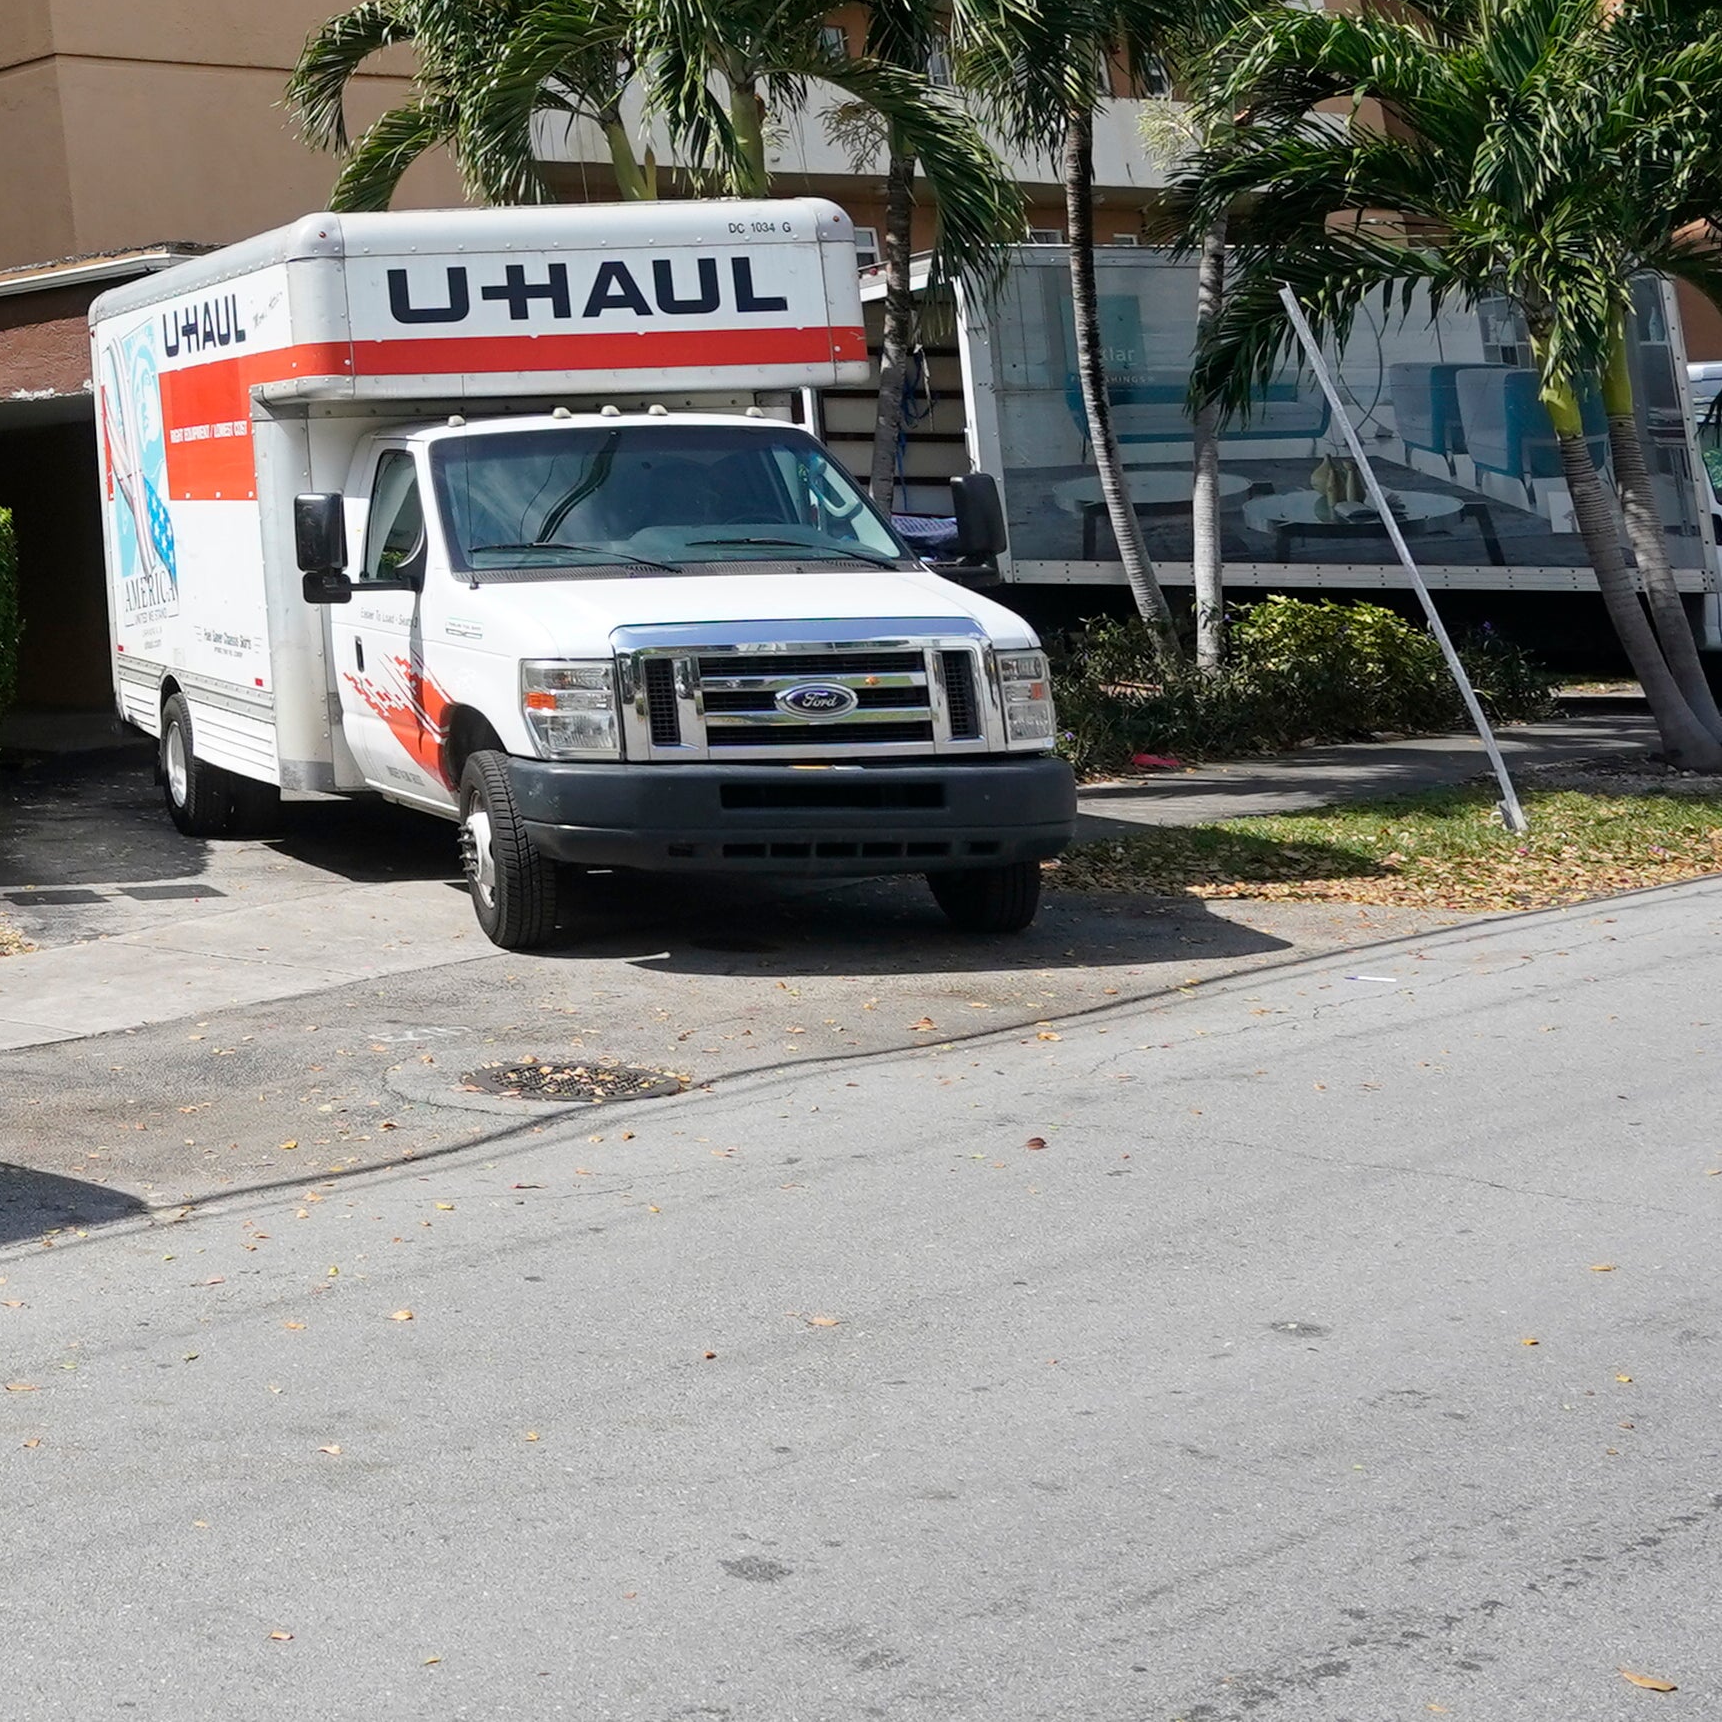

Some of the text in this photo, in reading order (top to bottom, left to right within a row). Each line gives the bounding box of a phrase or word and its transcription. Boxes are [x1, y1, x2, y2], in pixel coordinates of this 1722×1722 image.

[728, 221, 792, 234] DC 1034 G
[386, 256, 788, 325] U-HAUL
[162, 293, 247, 358] U-HAUL
[125, 569, 176, 613] AMERICA
[801, 691, 838, 708] Ford
